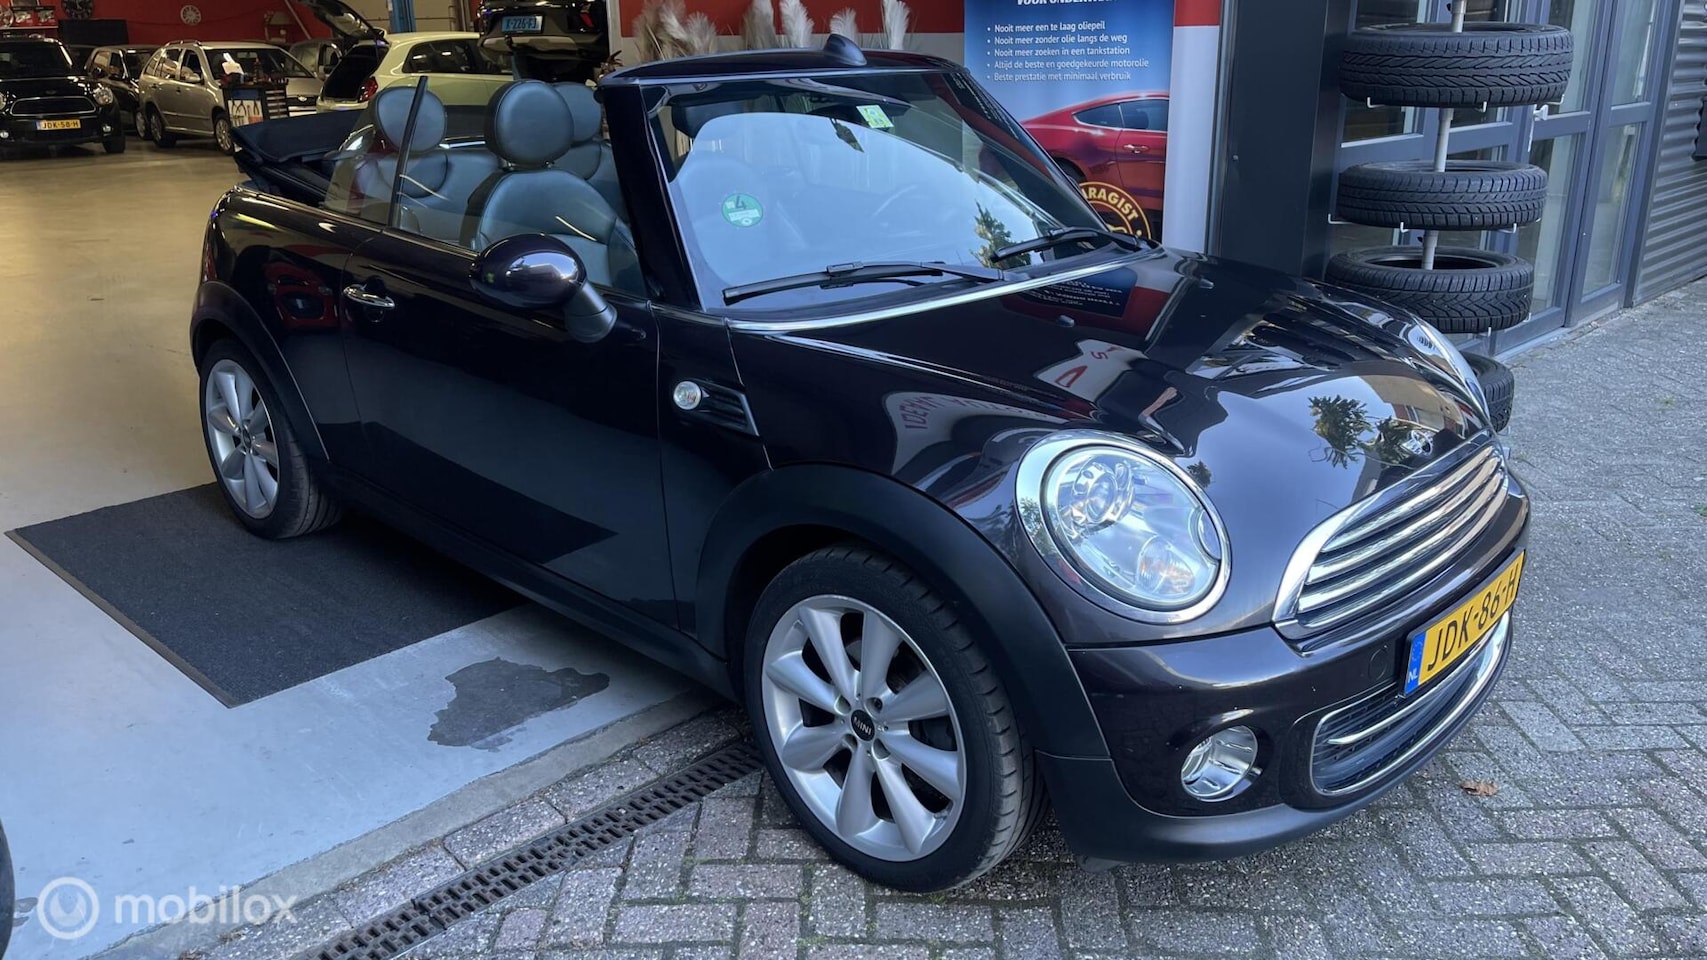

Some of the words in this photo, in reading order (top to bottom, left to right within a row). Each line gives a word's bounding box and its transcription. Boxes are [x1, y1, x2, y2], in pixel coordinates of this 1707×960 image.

[994, 24, 1014, 33] Nooit
[1050, 23, 1058, 31] te
[1059, 21, 1076, 32] laag
[1078, 20, 1106, 32] oliepeil
[994, 36, 1014, 45] Nooit
[1035, 34, 1060, 44] zonder
[1061, 34, 1076, 43] olie
[1077, 34, 1098, 45] langs
[1099, 33, 1109, 42] de
[1111, 35, 1128, 44] weg
[994, 48, 1013, 57] Nooit
[1034, 47, 1060, 56] zoeken
[1061, 47, 1069, 55] in
[1087, 46, 1130, 55] tankstation
[994, 60, 1013, 71] Altijd
[1014, 60, 1023, 69] de
[1024, 60, 1045, 69] beste
[1056, 59, 1109, 70] goedgekeurde
[1110, 58, 1149, 68] motorolie
[994, 72, 1014, 81] Beste
[1014, 71, 1047, 82] prestatie
[1047, 72, 1062, 80] met
[1063, 71, 1098, 81] minimaal
[1099, 71, 1131, 81] verbruik
[1427, 563, 1519, 671] JDK-86-H
[1408, 669, 1418, 683] NL
[853, 716, 872, 735] MINI
